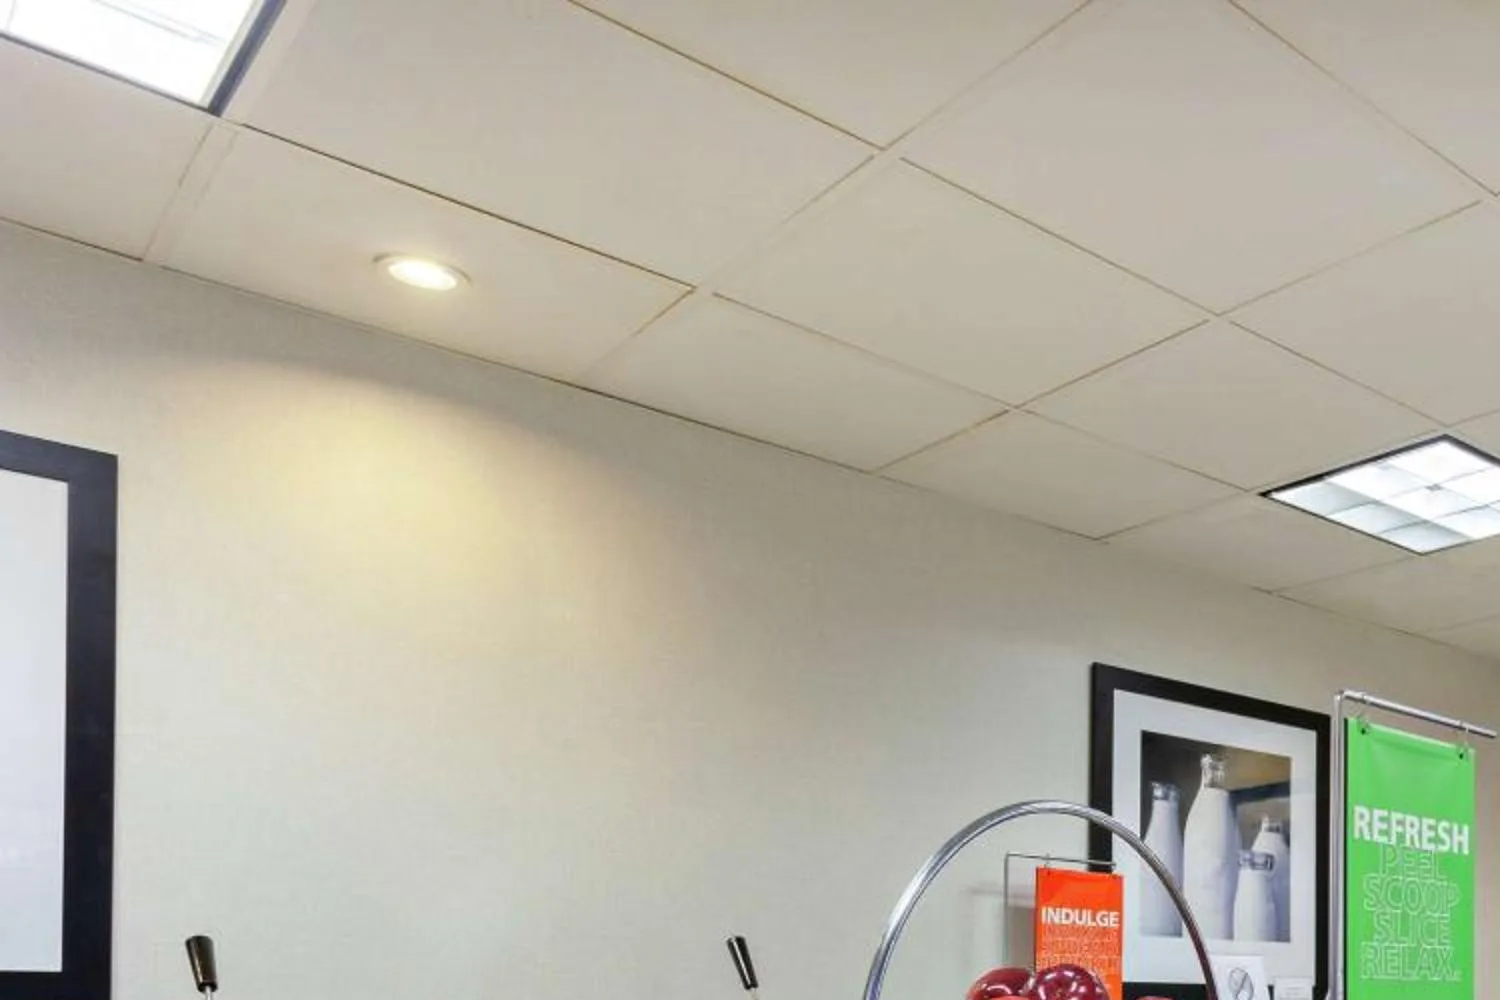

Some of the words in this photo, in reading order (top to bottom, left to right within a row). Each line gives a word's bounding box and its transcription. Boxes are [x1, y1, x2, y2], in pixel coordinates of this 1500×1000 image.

[1354, 805, 1469, 855] REFRESH
[1379, 842, 1448, 880] PEEL
[1363, 873, 1462, 917] SCOOP
[1041, 906, 1120, 928] INDULGE
[1373, 909, 1451, 948] SLICE
